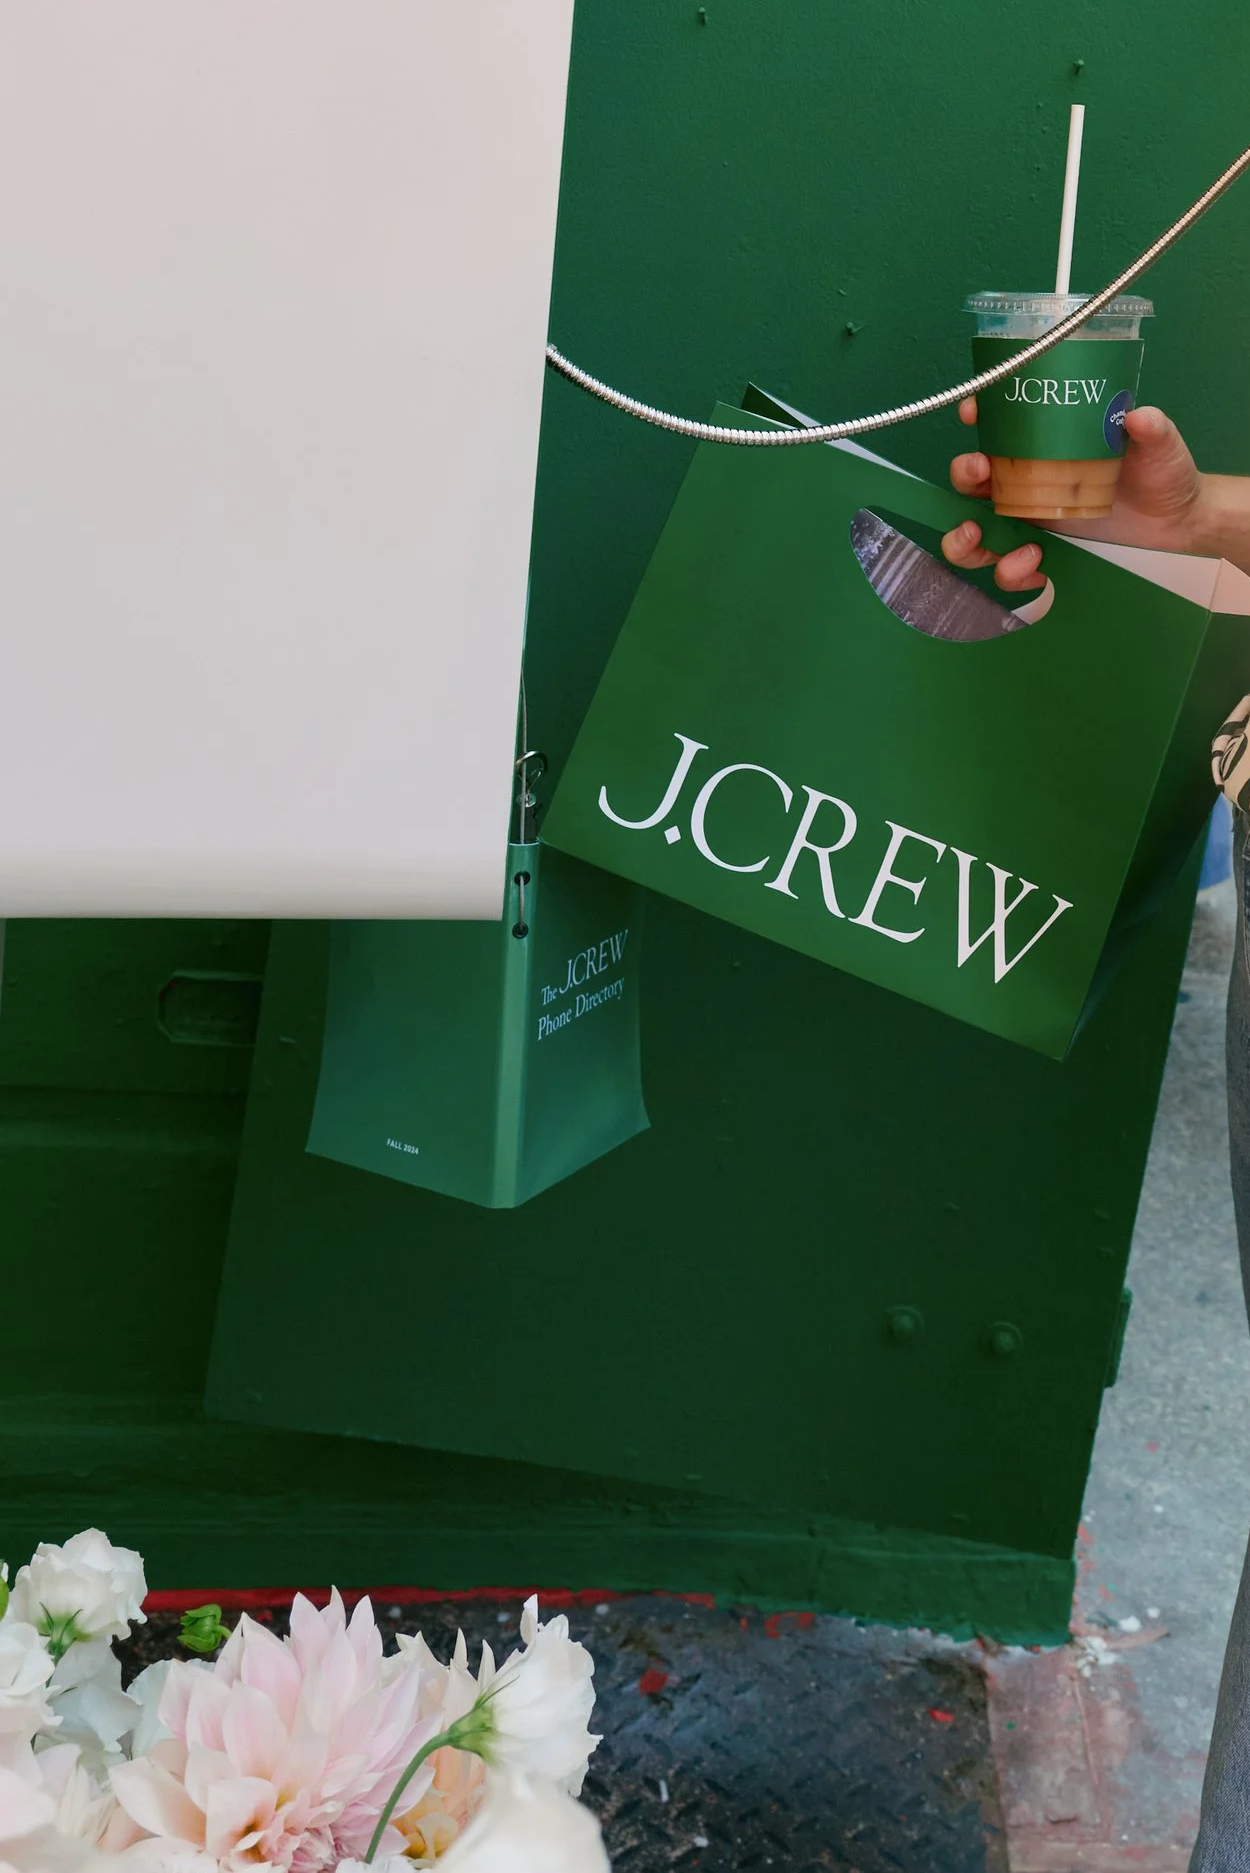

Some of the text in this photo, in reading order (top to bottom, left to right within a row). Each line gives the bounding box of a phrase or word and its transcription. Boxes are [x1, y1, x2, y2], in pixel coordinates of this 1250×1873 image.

[1004, 376, 1107, 405] J.CREW
[598, 732, 1074, 985] J.CREW
[541, 929, 629, 1006] The J.CREW
[537, 977, 625, 1041] Phone Directory
[386, 1138, 419, 1155] FALL 2024
